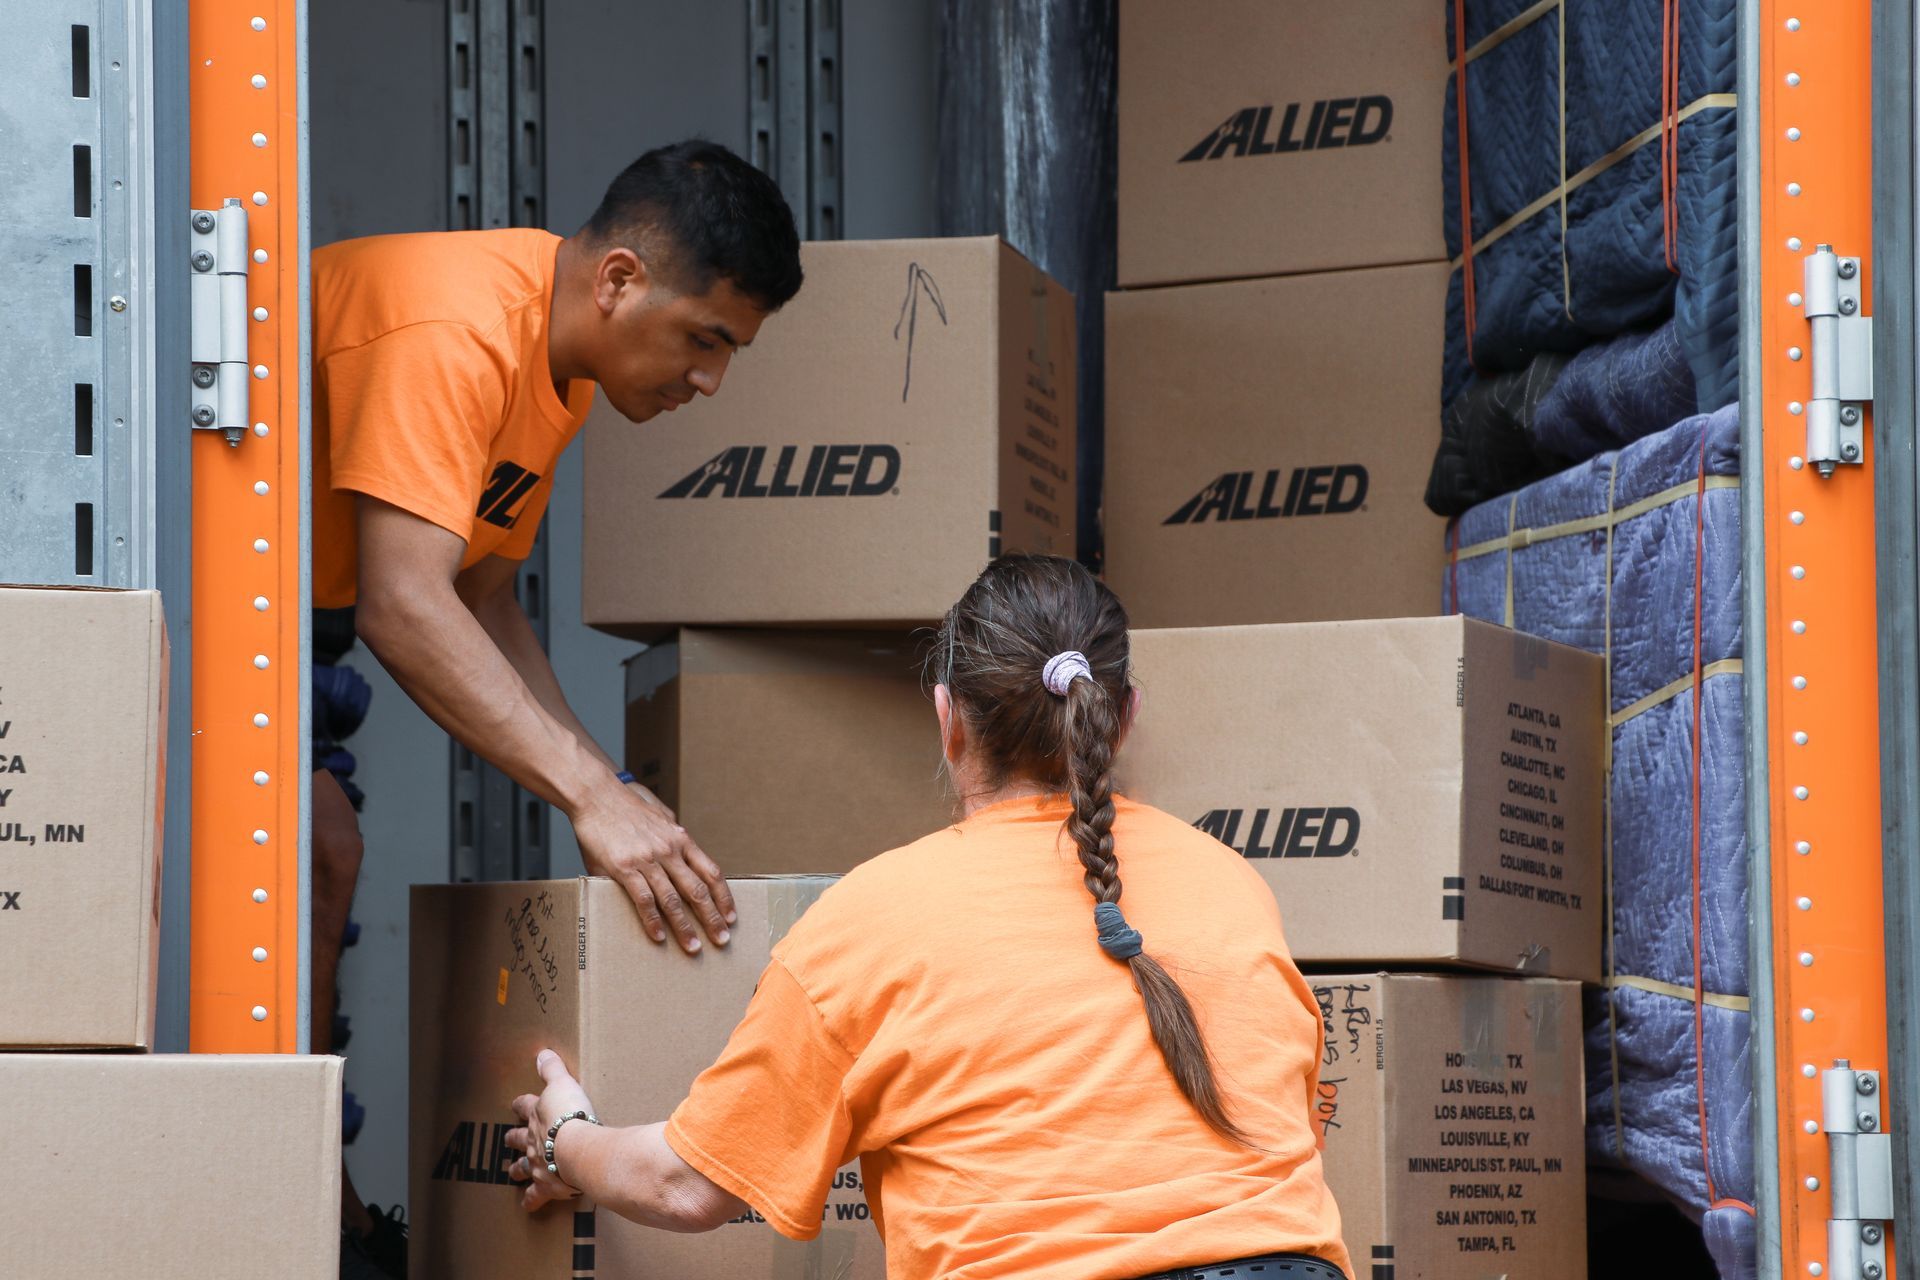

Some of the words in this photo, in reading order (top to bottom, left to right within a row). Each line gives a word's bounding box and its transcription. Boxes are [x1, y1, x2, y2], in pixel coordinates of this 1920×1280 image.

[1177, 95, 1393, 163] ALLIED
[656, 444, 901, 499] ALLIED
[1161, 464, 1369, 526] ALLIED
[1507, 702, 1547, 728] ATLANTA,
[1549, 713, 1561, 729] GA
[1511, 728, 1543, 752] AUSTIN,
[1545, 737, 1557, 753] TX
[1501, 751, 1551, 779] CHARLOTTE,
[1554, 764, 1565, 780] NC
[1508, 779, 1547, 804] CHICAGO,
[1549, 788, 1557, 804] IL
[1501, 803, 1550, 830] CINCINNATI,
[1552, 815, 1564, 831] OH
[45, 824, 84, 842] MN
[1192, 807, 1360, 858] ALLIED
[1500, 828, 1550, 855] CLEVELAND,
[1552, 840, 1564, 855] OH
[1501, 854, 1548, 879] COLUMBUS,
[1551, 865, 1562, 880] OH
[0, 892, 21, 910] X
[1480, 875, 1535, 899] DALLAS/FORT
[1537, 887, 1568, 909] WORTH,
[1570, 894, 1582, 910] TX
[1376, 1019, 1384, 1031] 1.5
[1376, 1033, 1384, 1070] BERGER
[1507, 1054, 1523, 1069] TX
[1442, 1079, 1463, 1094] LAS
[1467, 1079, 1508, 1097] VEGAS,
[1511, 1080, 1528, 1095] NV
[1435, 1105, 1457, 1120] LOS
[1460, 1105, 1516, 1123] ANGELES,
[1519, 1106, 1535, 1121] CA
[1441, 1132, 1511, 1149] LOUISVILLE,
[1514, 1132, 1530, 1147] KY
[1408, 1158, 1506, 1173] MINNEAPOLIS/ST.
[1509, 1158, 1541, 1174] PAUL,
[1544, 1158, 1562, 1173] MN
[1450, 1184, 1504, 1201] PHOENIX,
[1507, 1184, 1522, 1199] AZ
[836, 1203, 873, 1221] WO
[1436, 1211, 1459, 1226] SAN
[1463, 1210, 1518, 1227] ANTONIO,
[1521, 1210, 1537, 1225] TX
[1458, 1237, 1499, 1253] TAMPA,
[1502, 1237, 1515, 1251] FL
